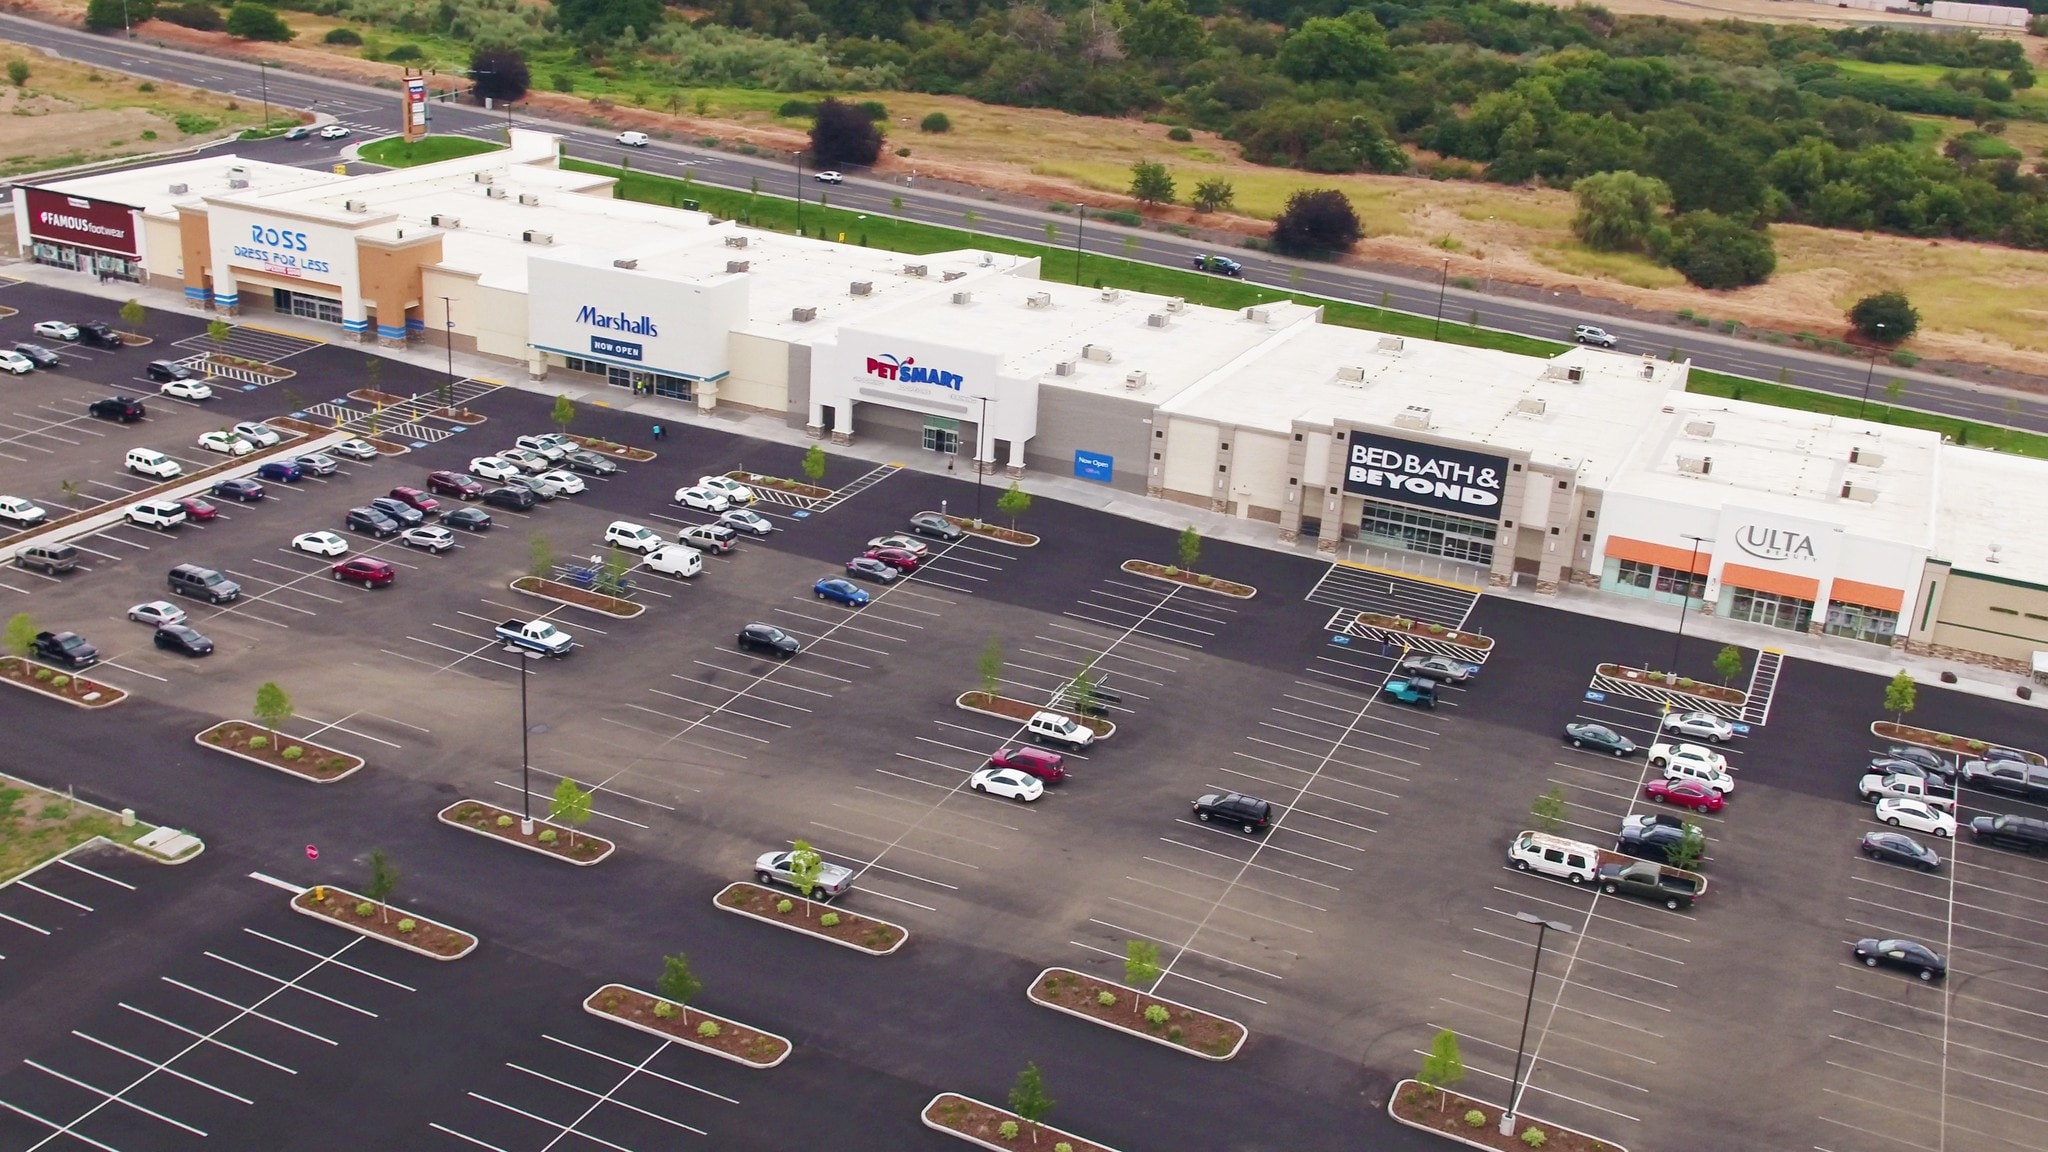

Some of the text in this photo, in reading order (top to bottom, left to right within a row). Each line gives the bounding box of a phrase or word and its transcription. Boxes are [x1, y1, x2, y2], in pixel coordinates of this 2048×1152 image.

[47, 212, 125, 238] FAMOUS footwear
[251, 224, 307, 252] ROSS
[234, 245, 269, 262] DRESS
[273, 252, 296, 267] FOR
[301, 258, 329, 273] LESS
[575, 305, 658, 338] Marshalls
[594, 341, 640, 357] NOW OPEN
[1351, 444, 1500, 489] BED BATH &
[1349, 465, 1499, 506] BEYOND
[1747, 525, 1815, 557] ULTA
